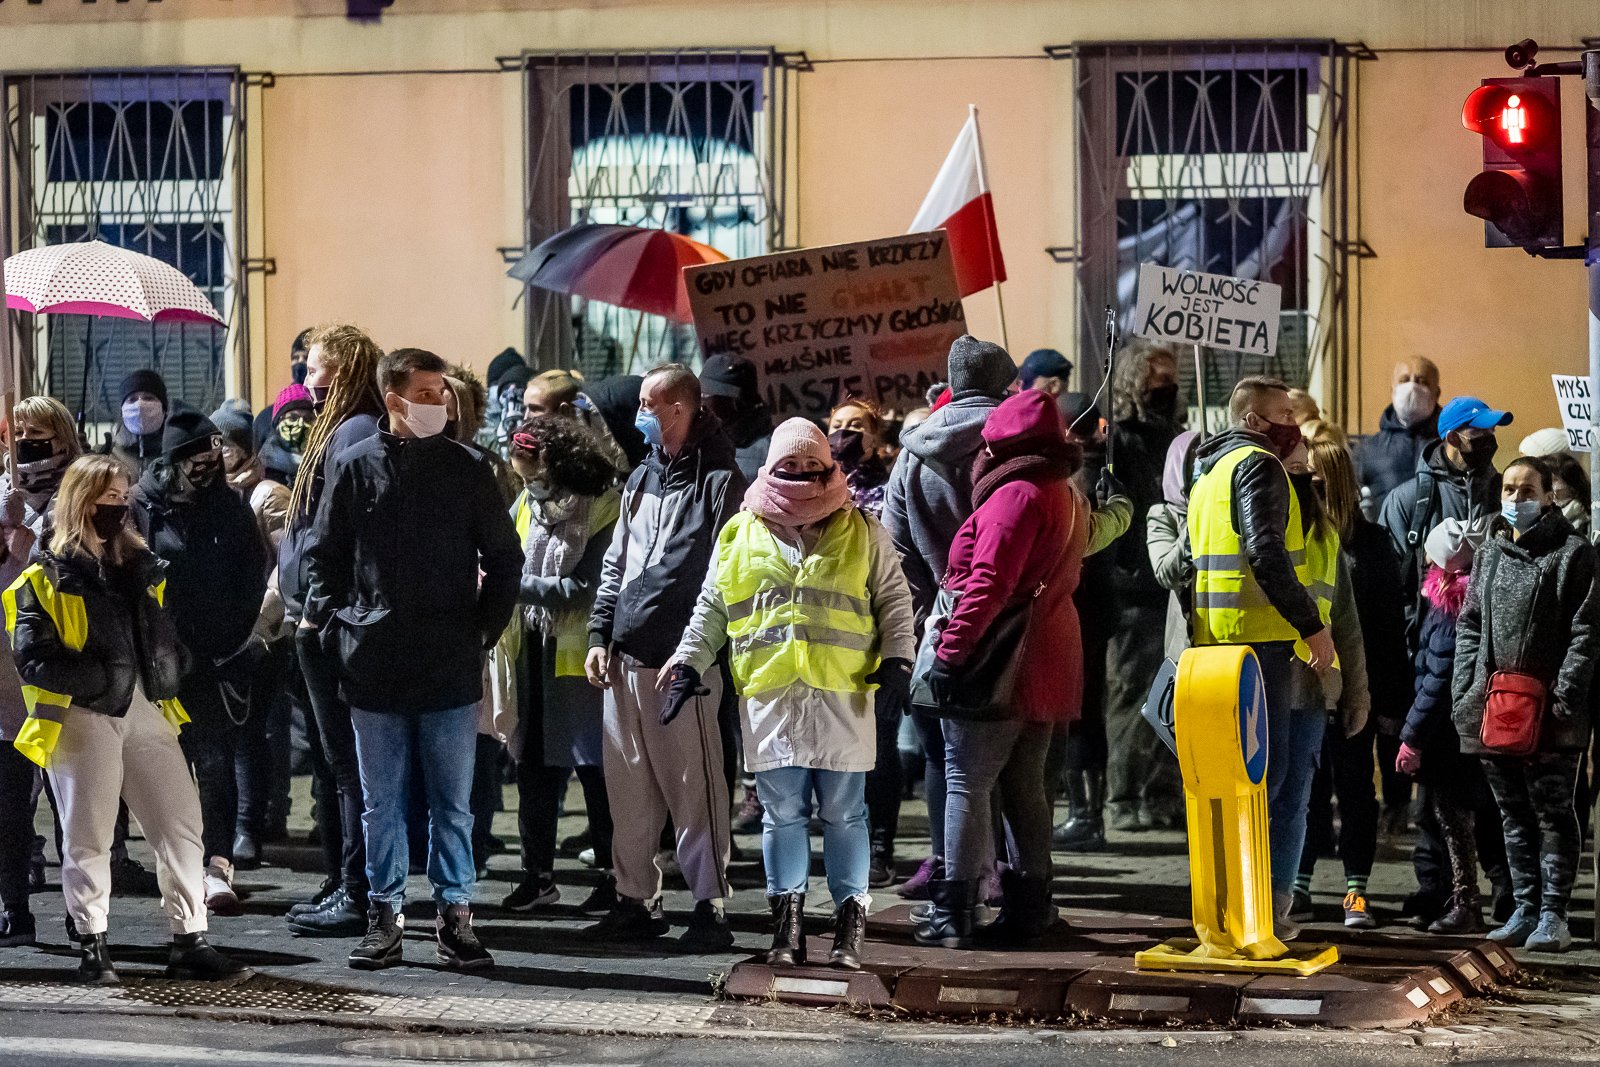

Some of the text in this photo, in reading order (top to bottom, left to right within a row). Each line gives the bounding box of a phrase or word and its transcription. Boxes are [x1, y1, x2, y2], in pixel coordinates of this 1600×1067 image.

[695, 268, 736, 295] GDY
[742, 257, 813, 288] OFIARA
[821, 249, 860, 272] NIE
[1162, 271, 1261, 305] WOLNOŚĆ
[714, 302, 756, 326] TO
[764, 293, 807, 320] NIE
[1181, 296, 1224, 314] JEST
[704, 329, 758, 359] WIĘC
[763, 312, 883, 347] KRZYCZMY
[1142, 302, 1269, 354] KOBIETĄ
[875, 370, 946, 404] PRA
